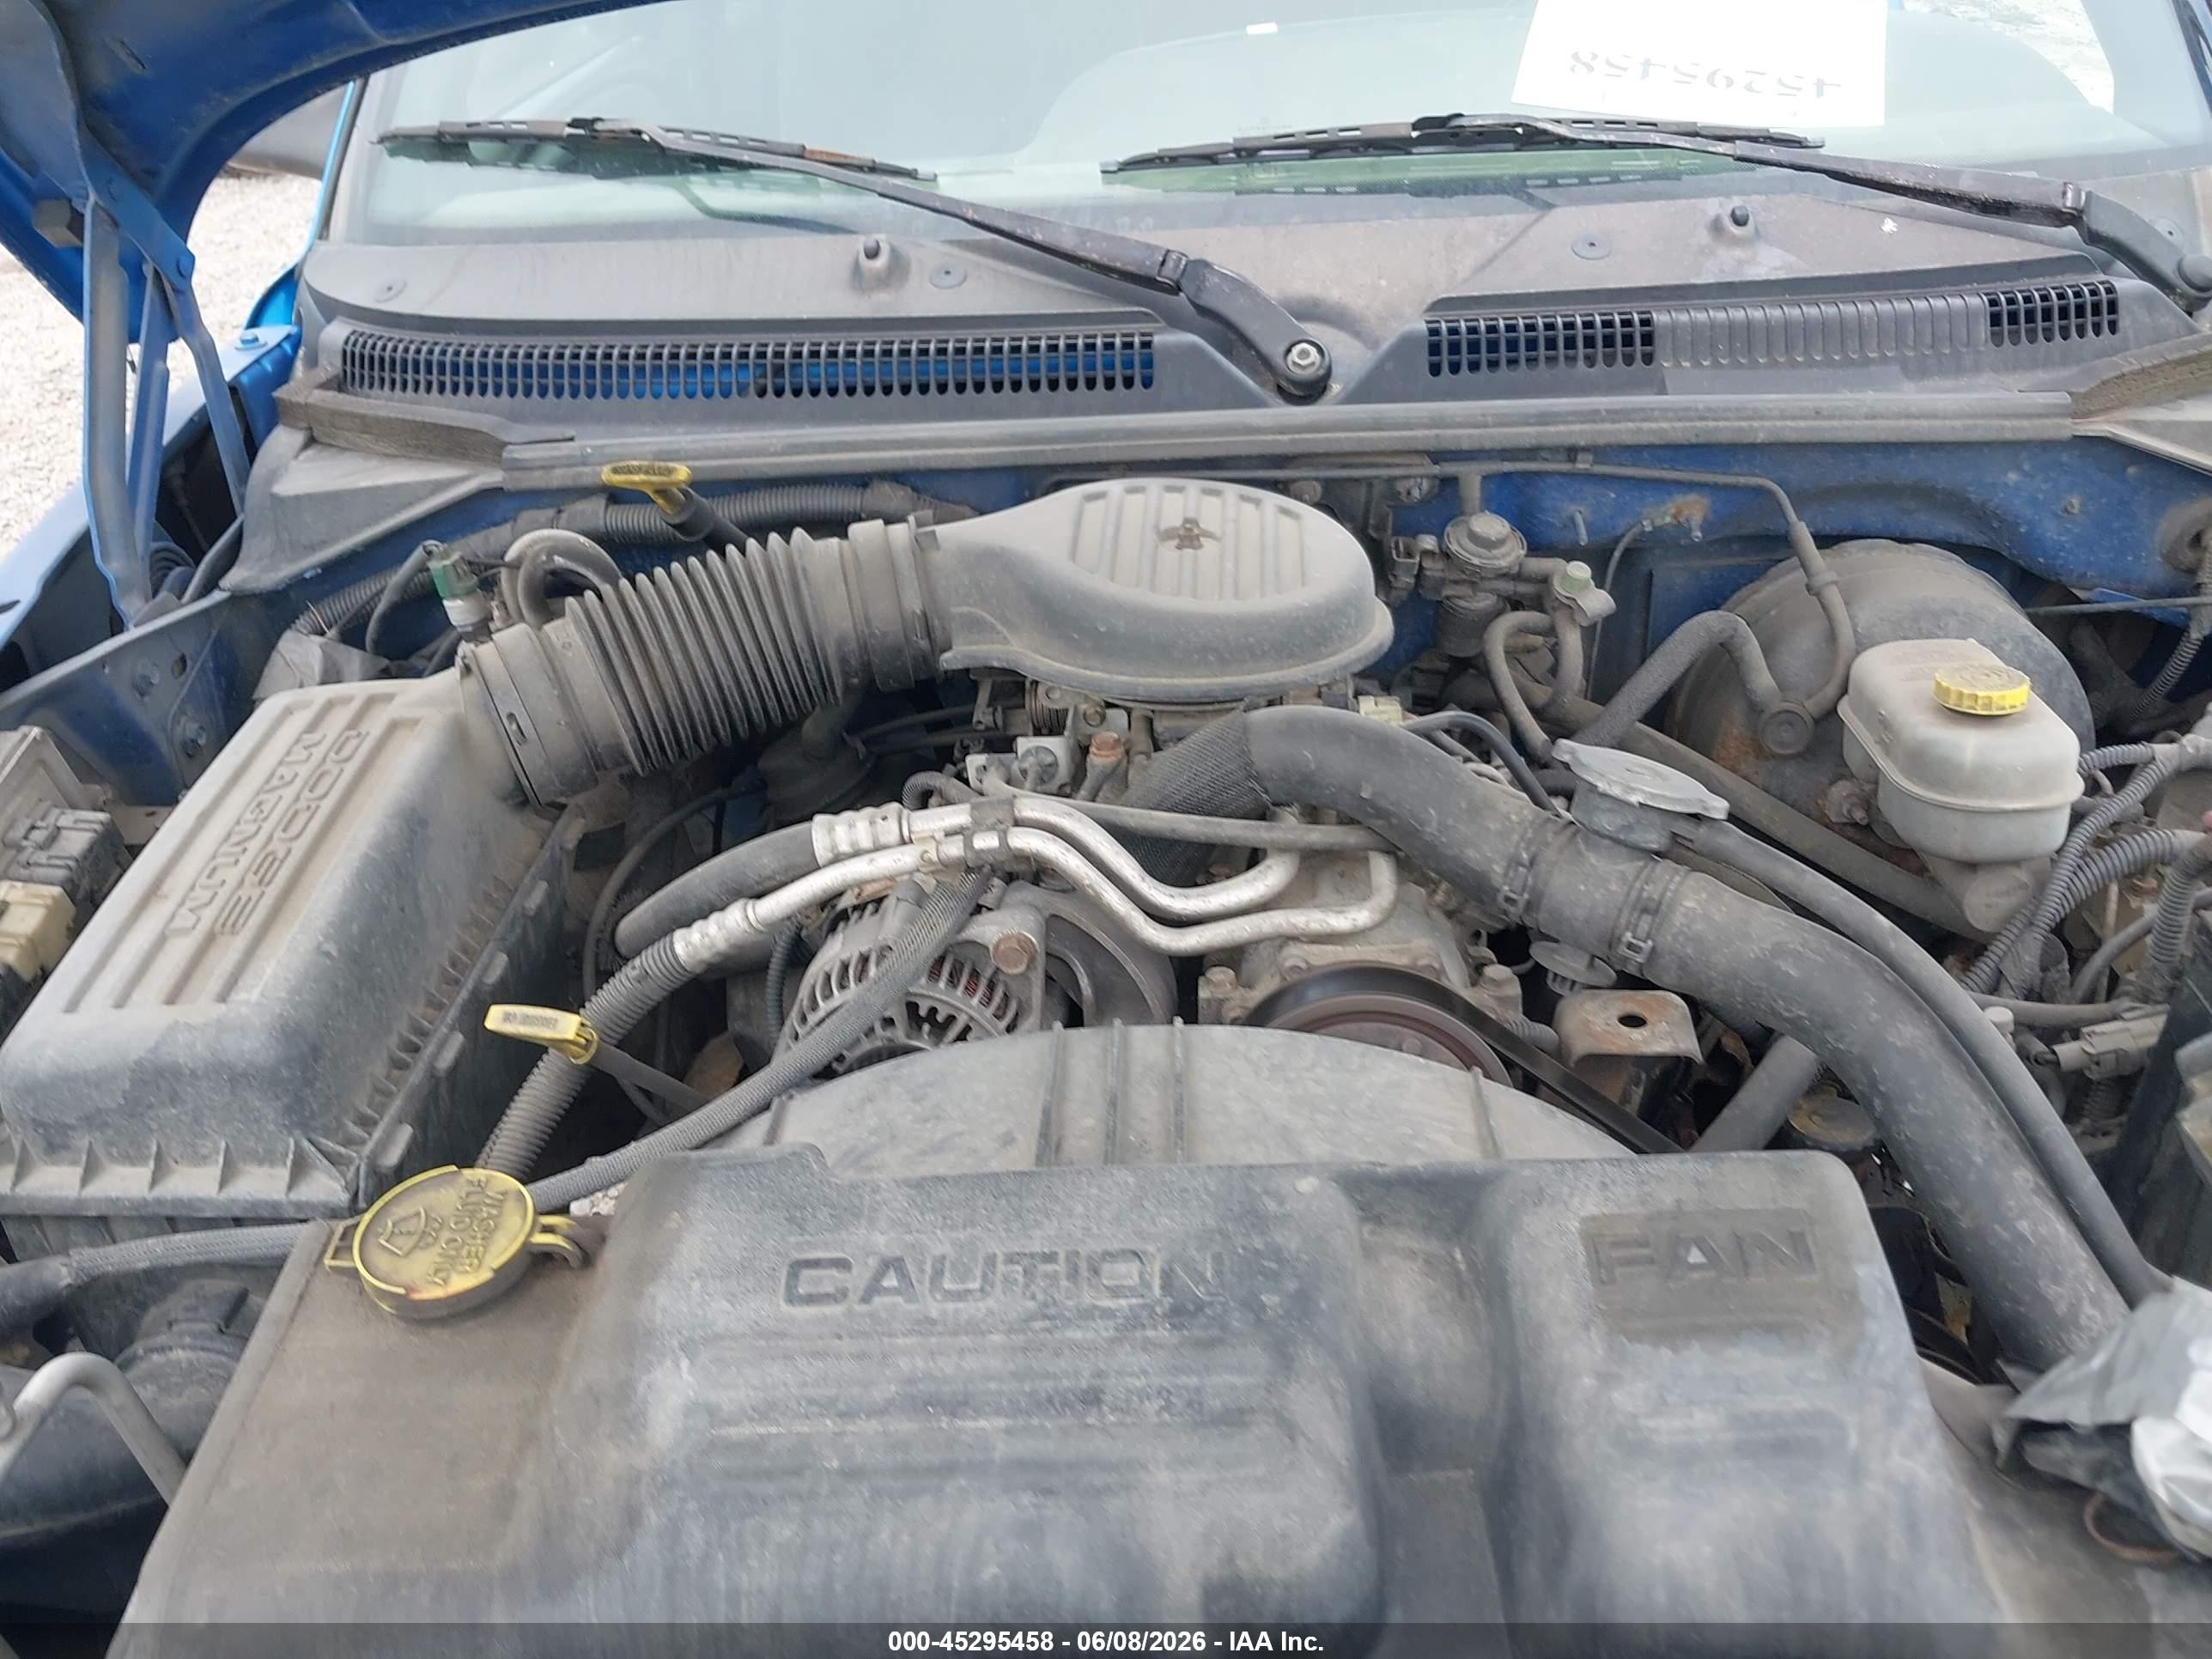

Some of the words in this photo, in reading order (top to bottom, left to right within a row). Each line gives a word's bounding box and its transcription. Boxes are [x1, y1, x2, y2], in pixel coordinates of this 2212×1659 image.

[163, 731, 328, 939] MAGNUM
[218, 730, 371, 936] DODGE
[455, 1188, 508, 1273] WASHER
[1585, 1228, 1819, 1286] FAN
[780, 1247, 1228, 1311] CAUTION
